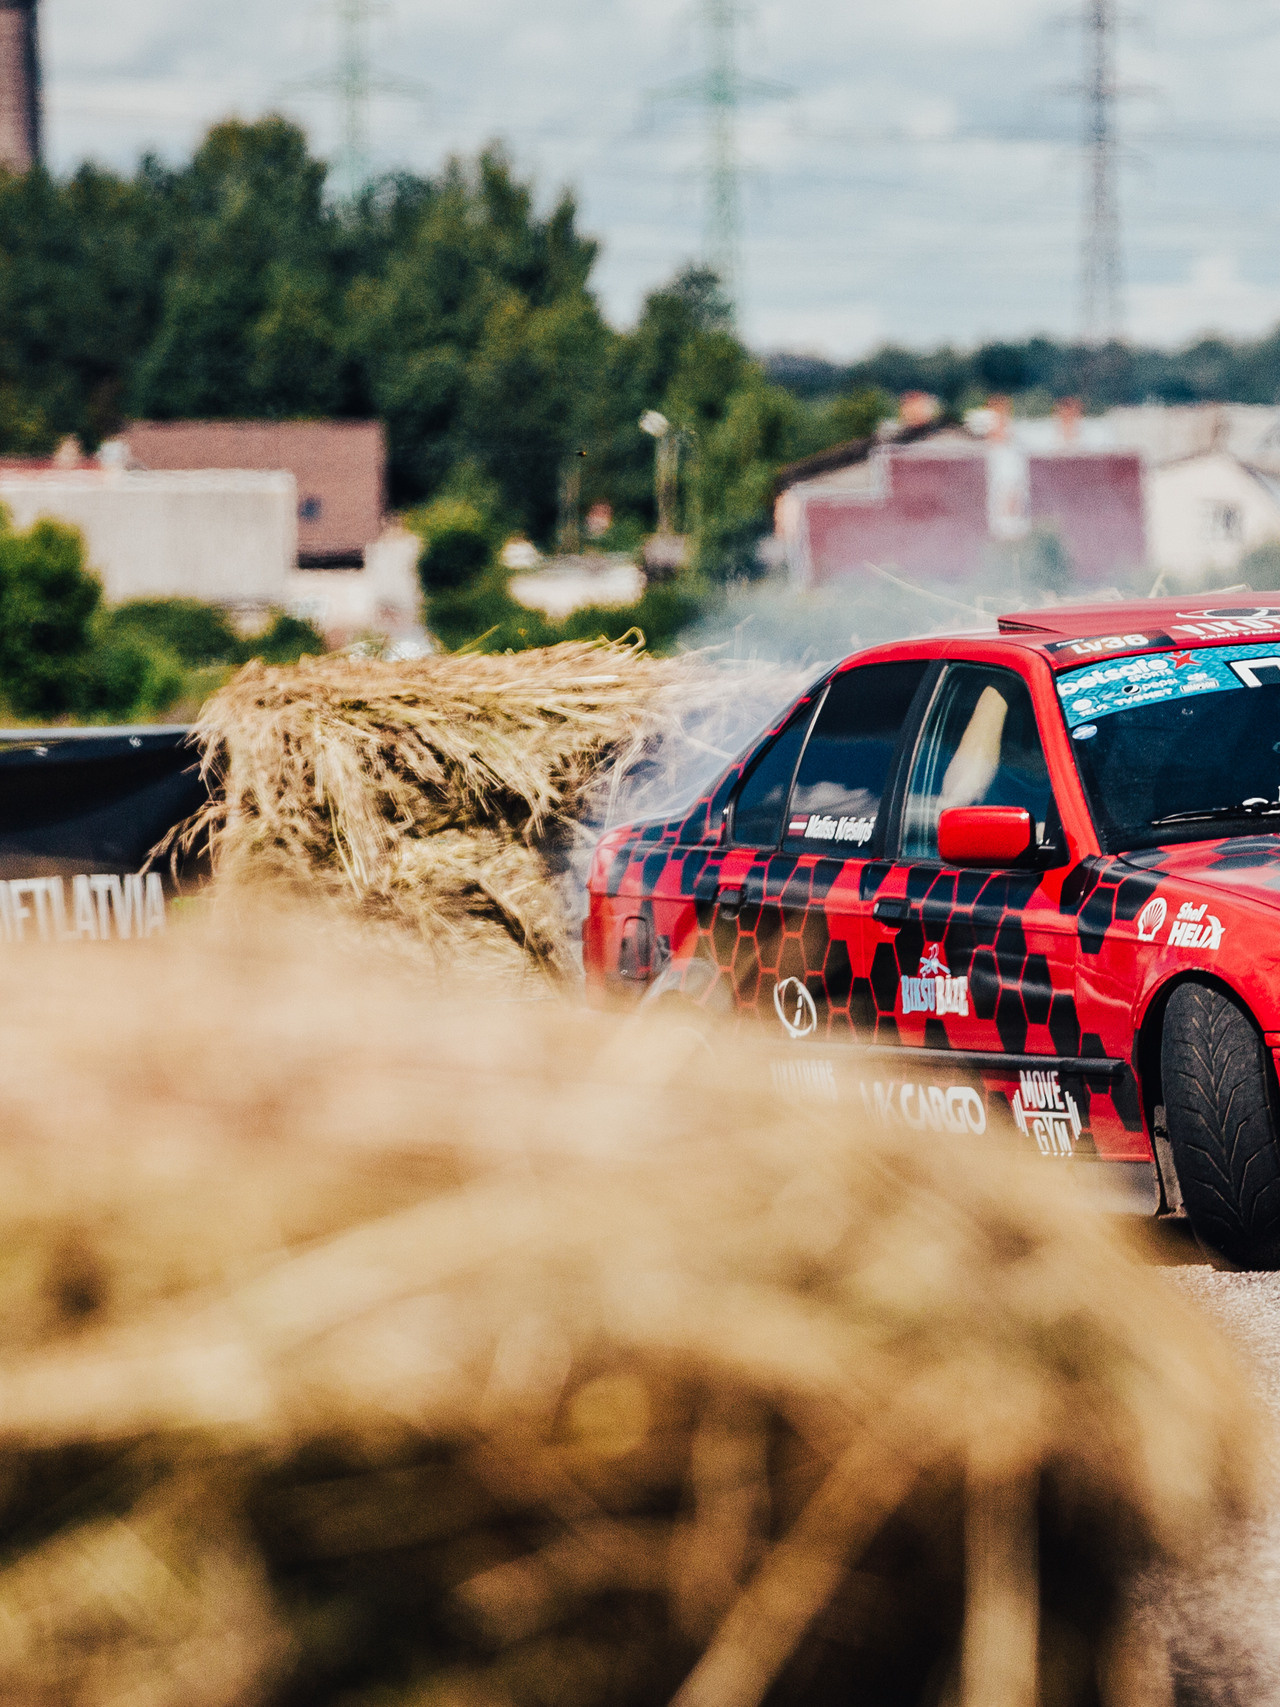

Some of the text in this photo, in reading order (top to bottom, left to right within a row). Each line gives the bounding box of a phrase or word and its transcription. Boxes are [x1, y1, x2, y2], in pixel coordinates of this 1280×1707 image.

[1056, 659, 1169, 697] betsafe
[1127, 668, 1174, 682] SPORTS
[1142, 678, 1180, 692] pepsi
[1176, 902, 1208, 922] Shell
[1167, 914, 1226, 950] HELIX
[1019, 1069, 1066, 1111] MOVE
[899, 1083, 987, 1135] CARGO
[1032, 1112, 1074, 1157] GYM
